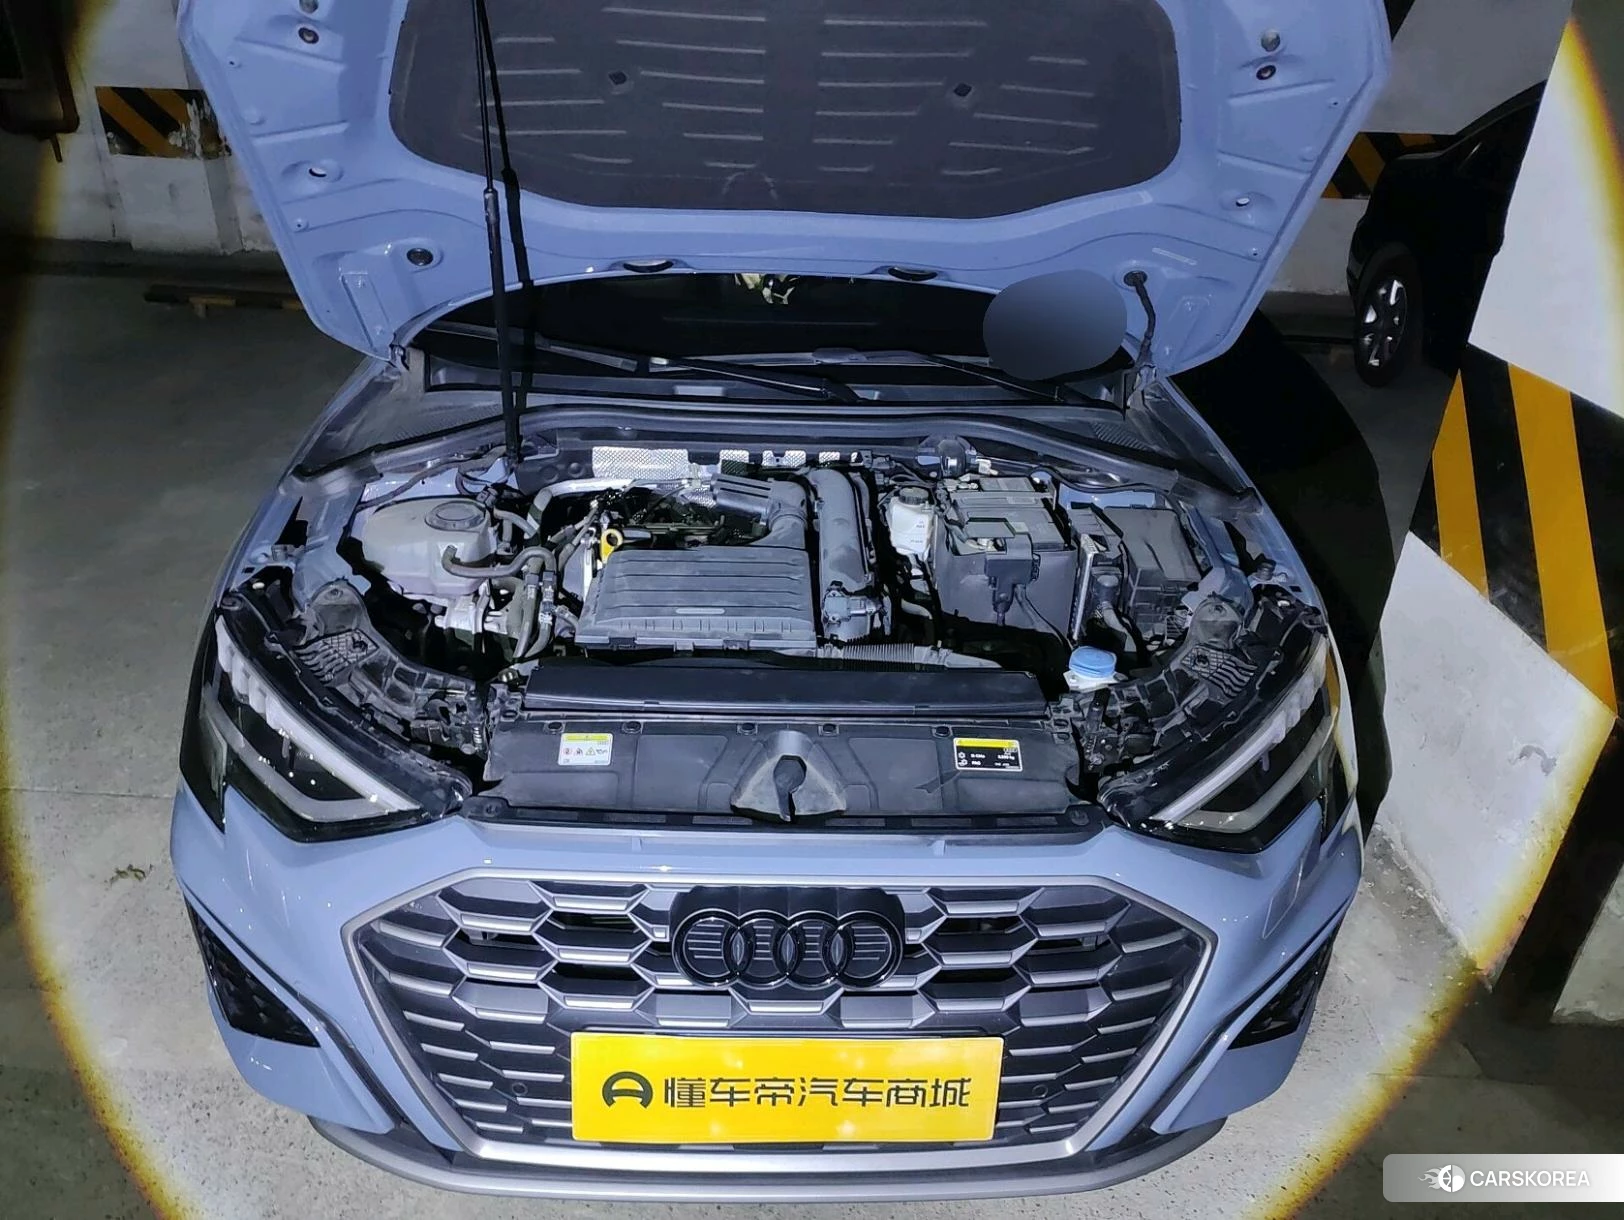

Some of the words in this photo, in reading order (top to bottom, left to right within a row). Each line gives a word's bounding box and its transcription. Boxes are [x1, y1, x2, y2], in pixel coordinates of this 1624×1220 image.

[664, 1076, 972, 1109] 懂车帝汽车商城
